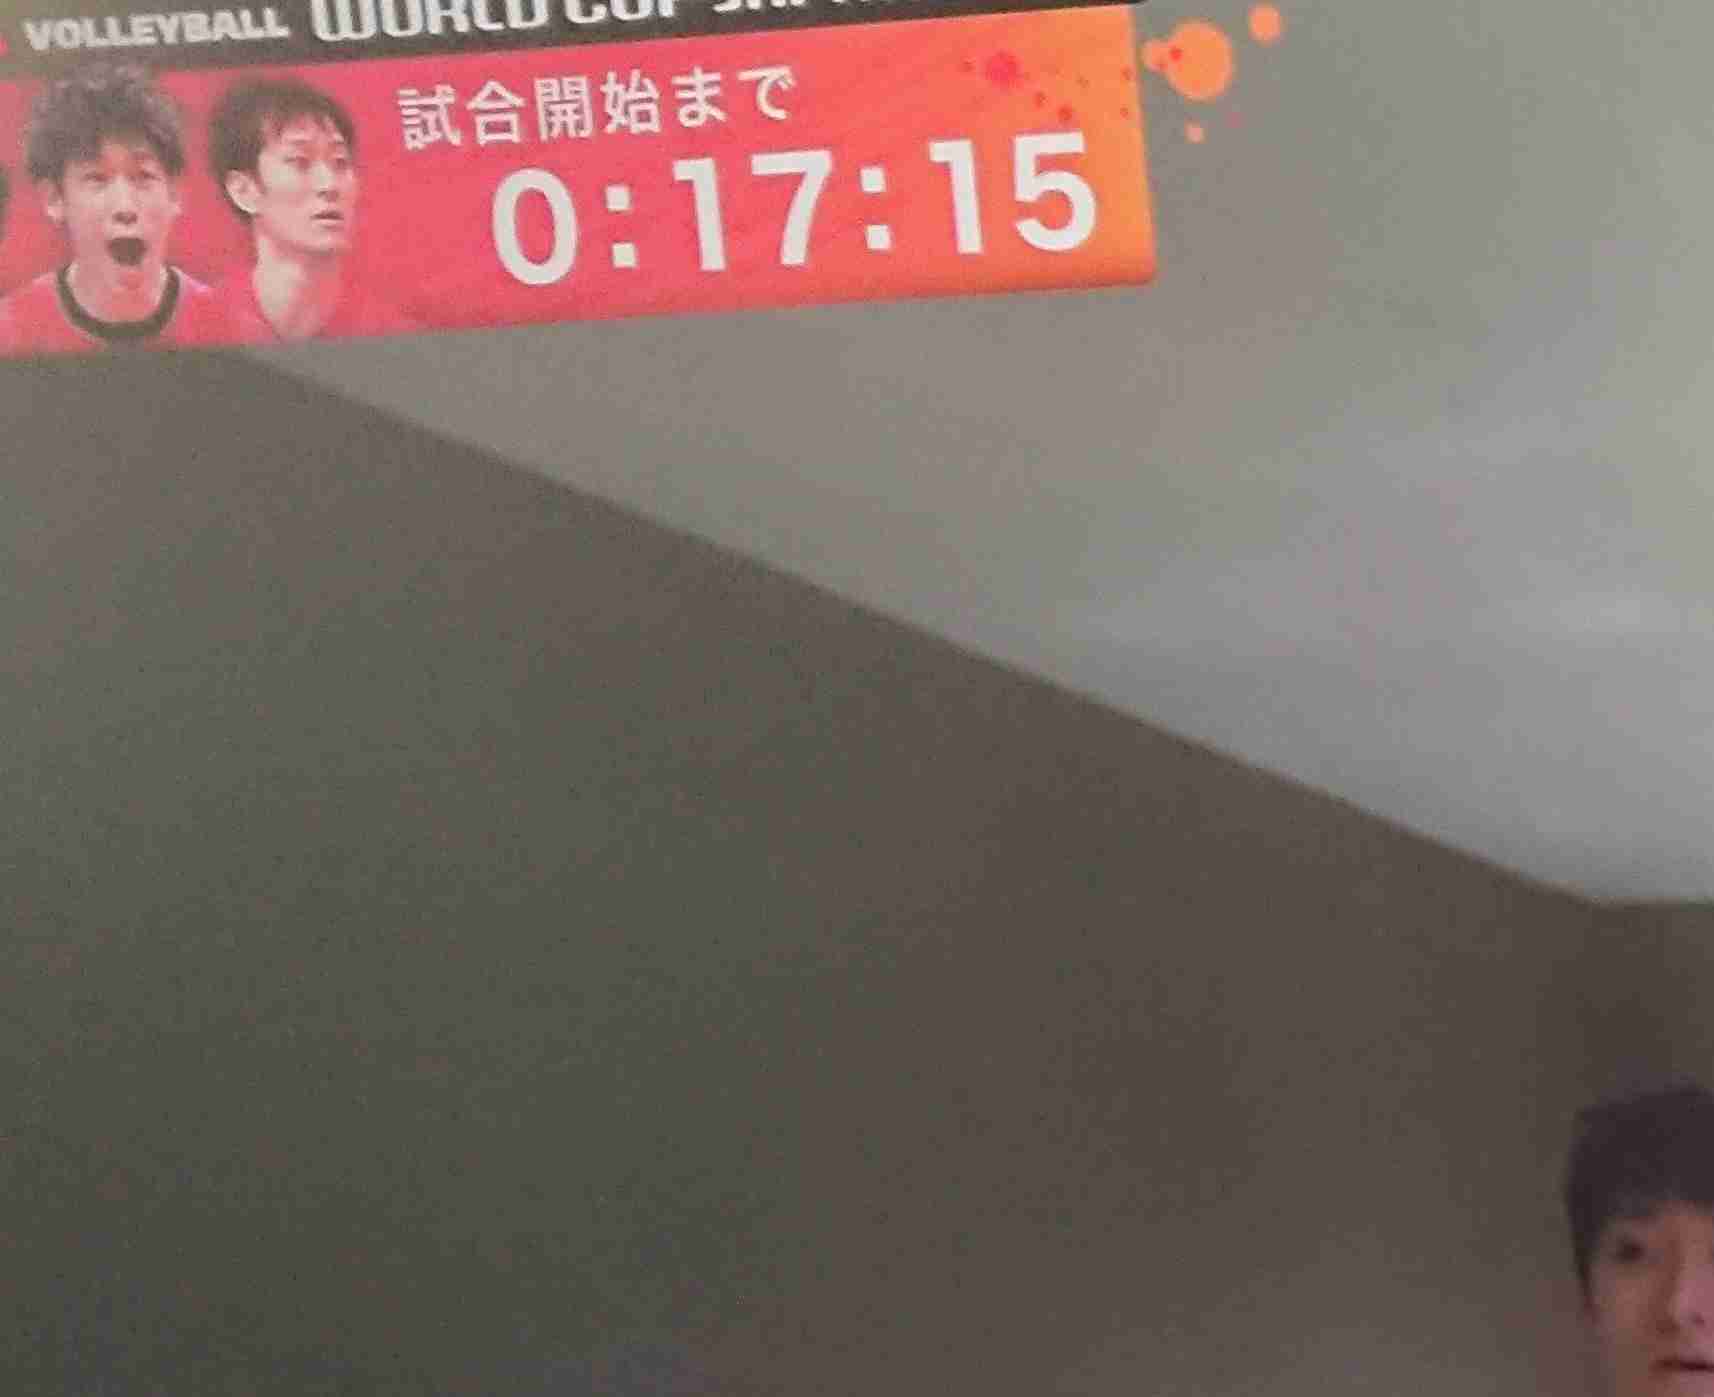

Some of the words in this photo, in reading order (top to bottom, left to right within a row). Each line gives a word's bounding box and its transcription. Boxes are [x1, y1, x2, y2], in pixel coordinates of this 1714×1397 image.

[23, 7, 289, 51] VOLLEYBALL
[311, 0, 548, 42] WORLD
[397, 64, 797, 152] 試合開始まで
[491, 130, 1098, 286] 0:17:15
